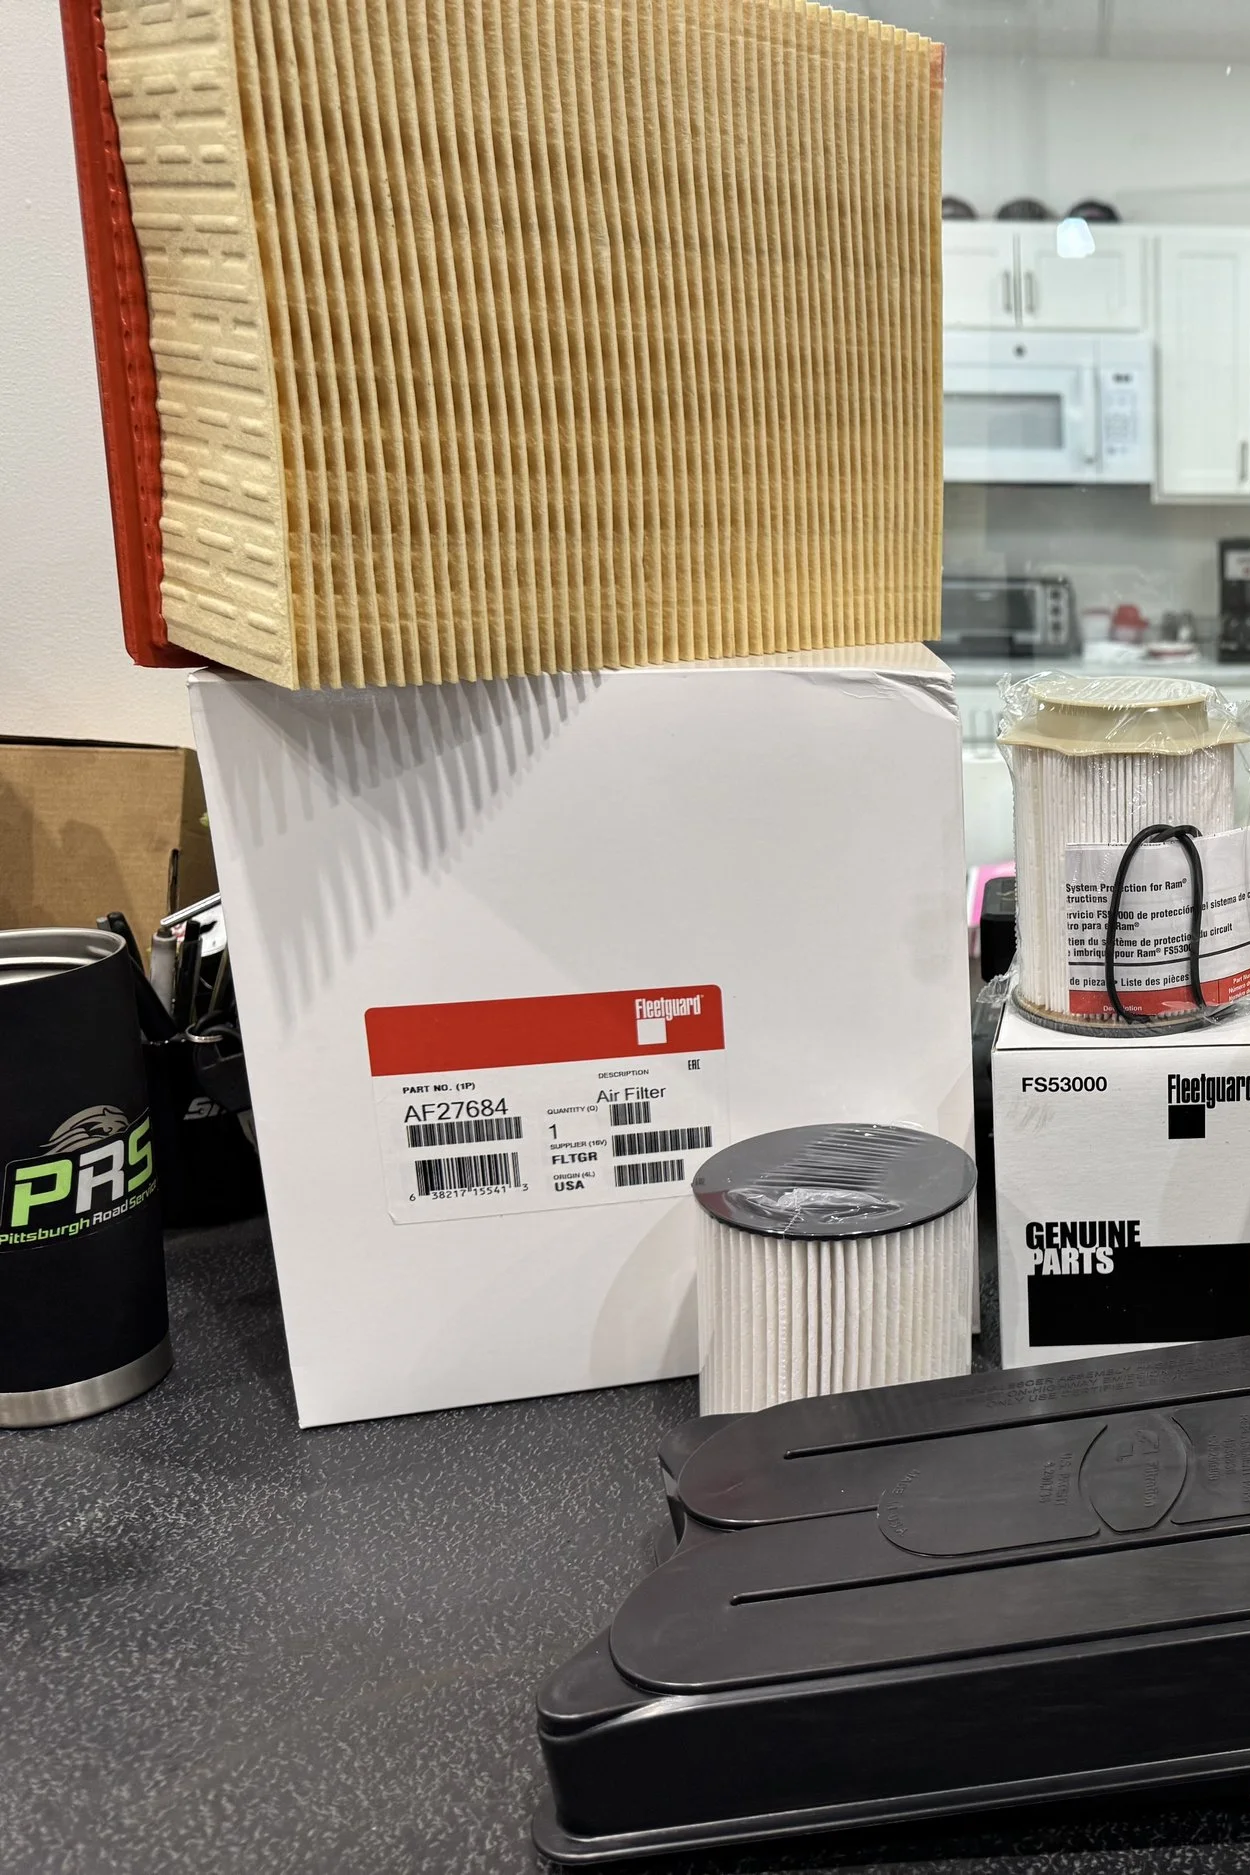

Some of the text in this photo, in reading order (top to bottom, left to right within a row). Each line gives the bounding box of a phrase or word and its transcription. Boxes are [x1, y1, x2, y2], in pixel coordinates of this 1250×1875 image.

[1065, 883, 1098, 894] System
[1100, 883, 1147, 893] Proction
[1149, 882, 1163, 892] for
[1096, 909, 1134, 920] FS000
[1137, 910, 1148, 920] de
[1210, 896, 1237, 909] sistema
[1238, 892, 1246, 901] de
[1081, 922, 1101, 932] para
[1088, 937, 1099, 946] du
[1101, 937, 1138, 947] stème
[1140, 938, 1151, 947] de
[1153, 932, 1192, 948] protectio
[1209, 922, 1233, 937] circuit
[1073, 948, 1107, 958] imbriqu
[1114, 949, 1134, 959] pour
[1163, 943, 1192, 956] FS5300
[1069, 977, 1081, 986] de
[1120, 977, 1142, 987] Liste
[1145, 976, 1161, 986] des
[1163, 973, 1190, 986] pièces
[635, 995, 702, 1021] Fleetguard
[598, 1069, 650, 1079] DESCRIPTION
[402, 1082, 476, 1094] PART NO. (1P)
[1021, 1076, 1108, 1093] FS53000
[596, 1086, 667, 1104] Air Filter
[404, 1097, 509, 1123] AF27684
[547, 1105, 586, 1116] QUANTITY
[548, 1123, 558, 1140] 1
[550, 1140, 587, 1151] SUPPLIER
[552, 1151, 598, 1165] FLTGR
[11, 1115, 153, 1228] PRS
[553, 1172, 581, 1181] ORIGIN
[409, 1182, 529, 1202] 6 38217 15541 3
[555, 1180, 585, 1192] USA
[0, 1178, 158, 1246] Pittsburgh Road Servic
[1025, 1220, 1141, 1250] GENUINE
[1032, 1247, 1114, 1276] PARTS
